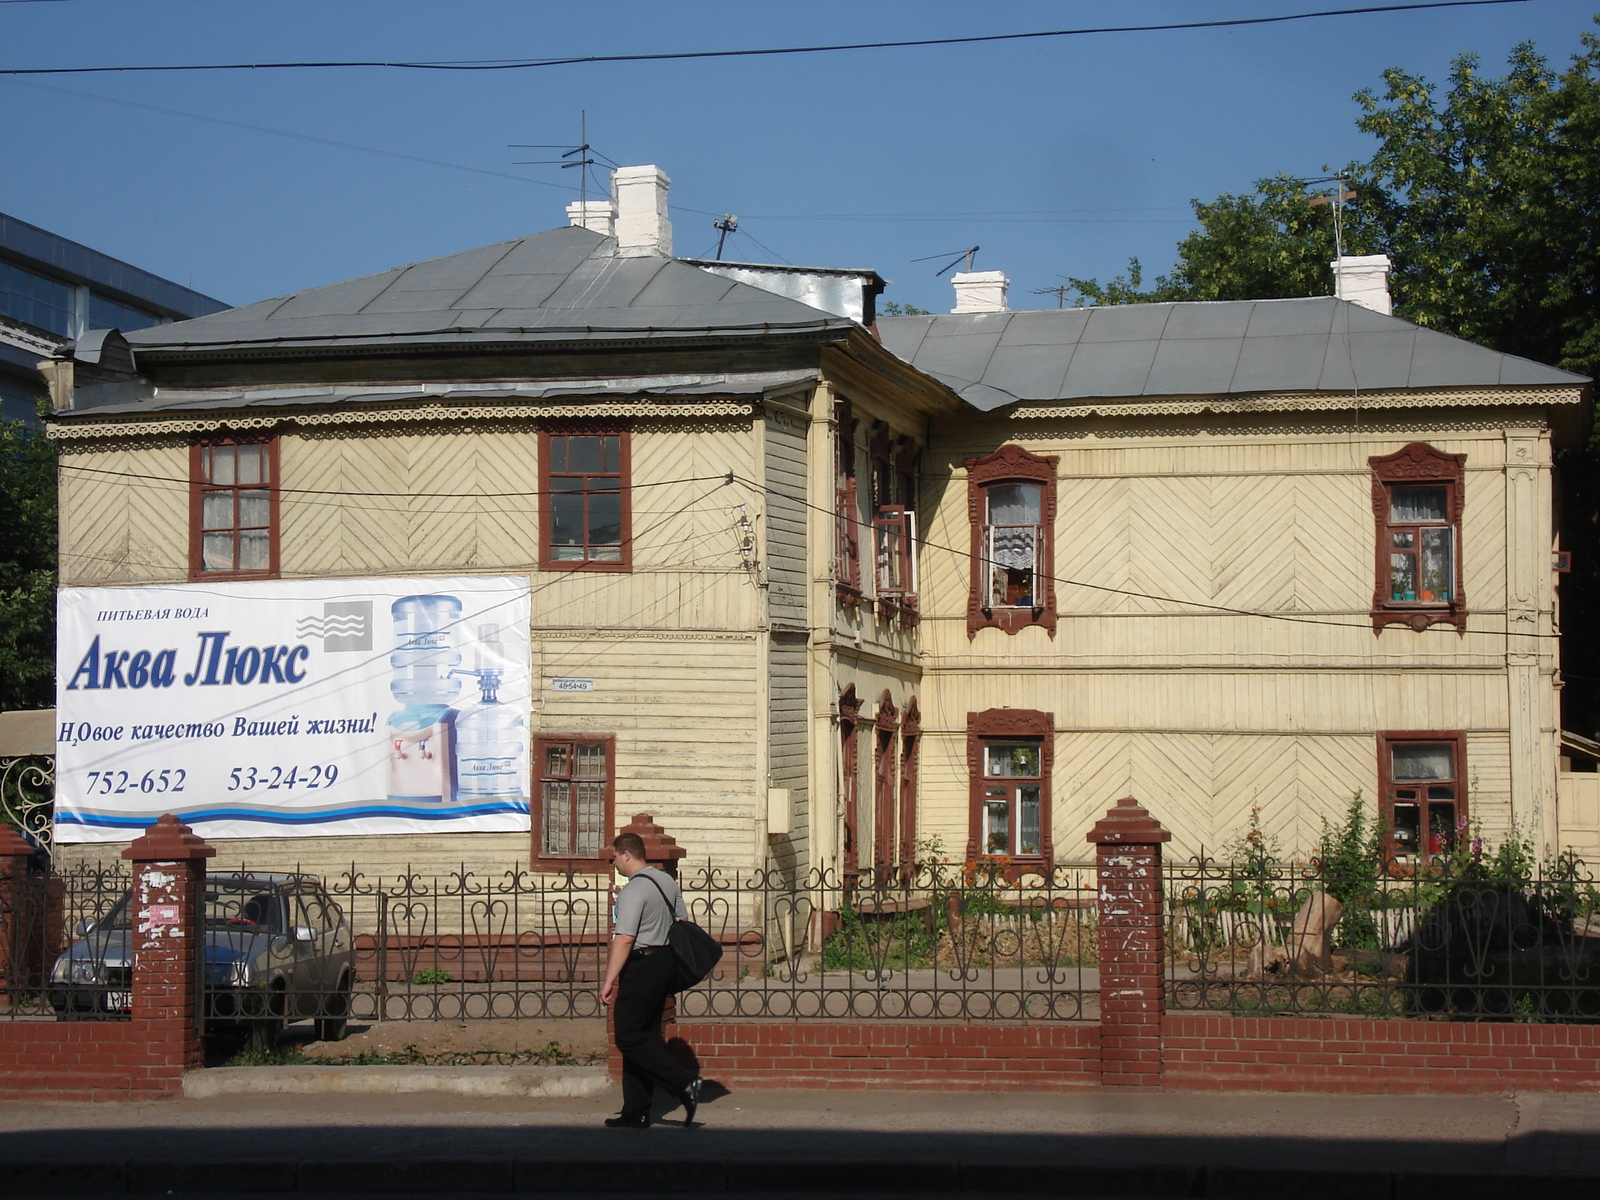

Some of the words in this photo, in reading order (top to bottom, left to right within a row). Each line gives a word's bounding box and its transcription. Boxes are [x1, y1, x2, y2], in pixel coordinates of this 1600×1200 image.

[97, 608, 170, 622] ПИТЬЕВАЯ
[174, 607, 209, 619] ВОДА
[65, 633, 178, 690] Аква
[184, 630, 309, 686] Люкс
[131, 721, 225, 740] качество
[231, 714, 299, 737] Вашей
[306, 712, 377, 735] жизни!
[86, 769, 187, 795] 752-652
[227, 764, 339, 791] 53-24-29
